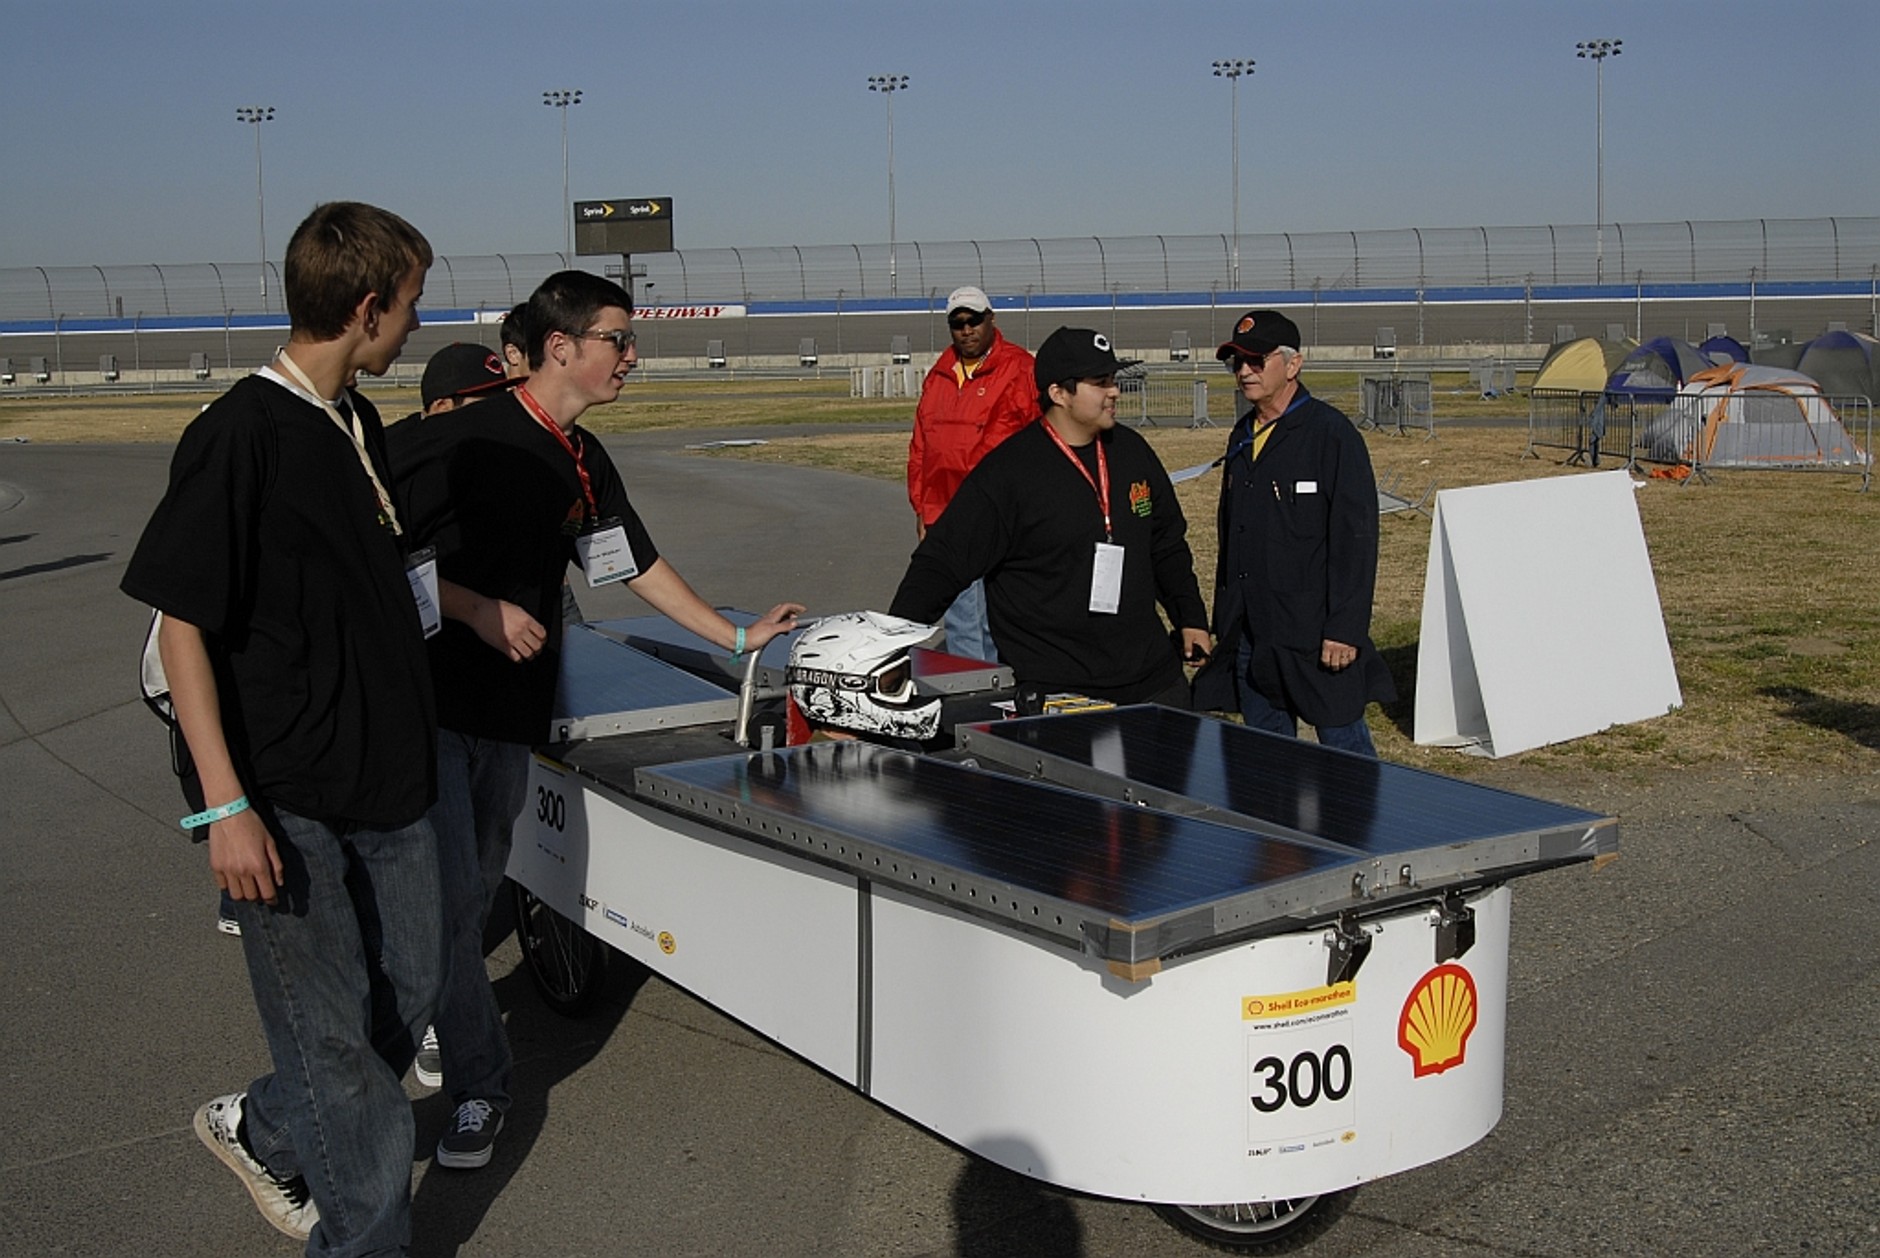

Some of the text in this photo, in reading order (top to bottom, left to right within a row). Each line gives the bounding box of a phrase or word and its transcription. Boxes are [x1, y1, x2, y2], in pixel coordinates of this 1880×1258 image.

[583, 207, 604, 218] Sprint
[631, 306, 726, 319] PEEDWAY
[537, 784, 565, 832] 300
[1268, 989, 1351, 1011] Shell Eco-marathon
[1250, 1044, 1353, 1113] 300
